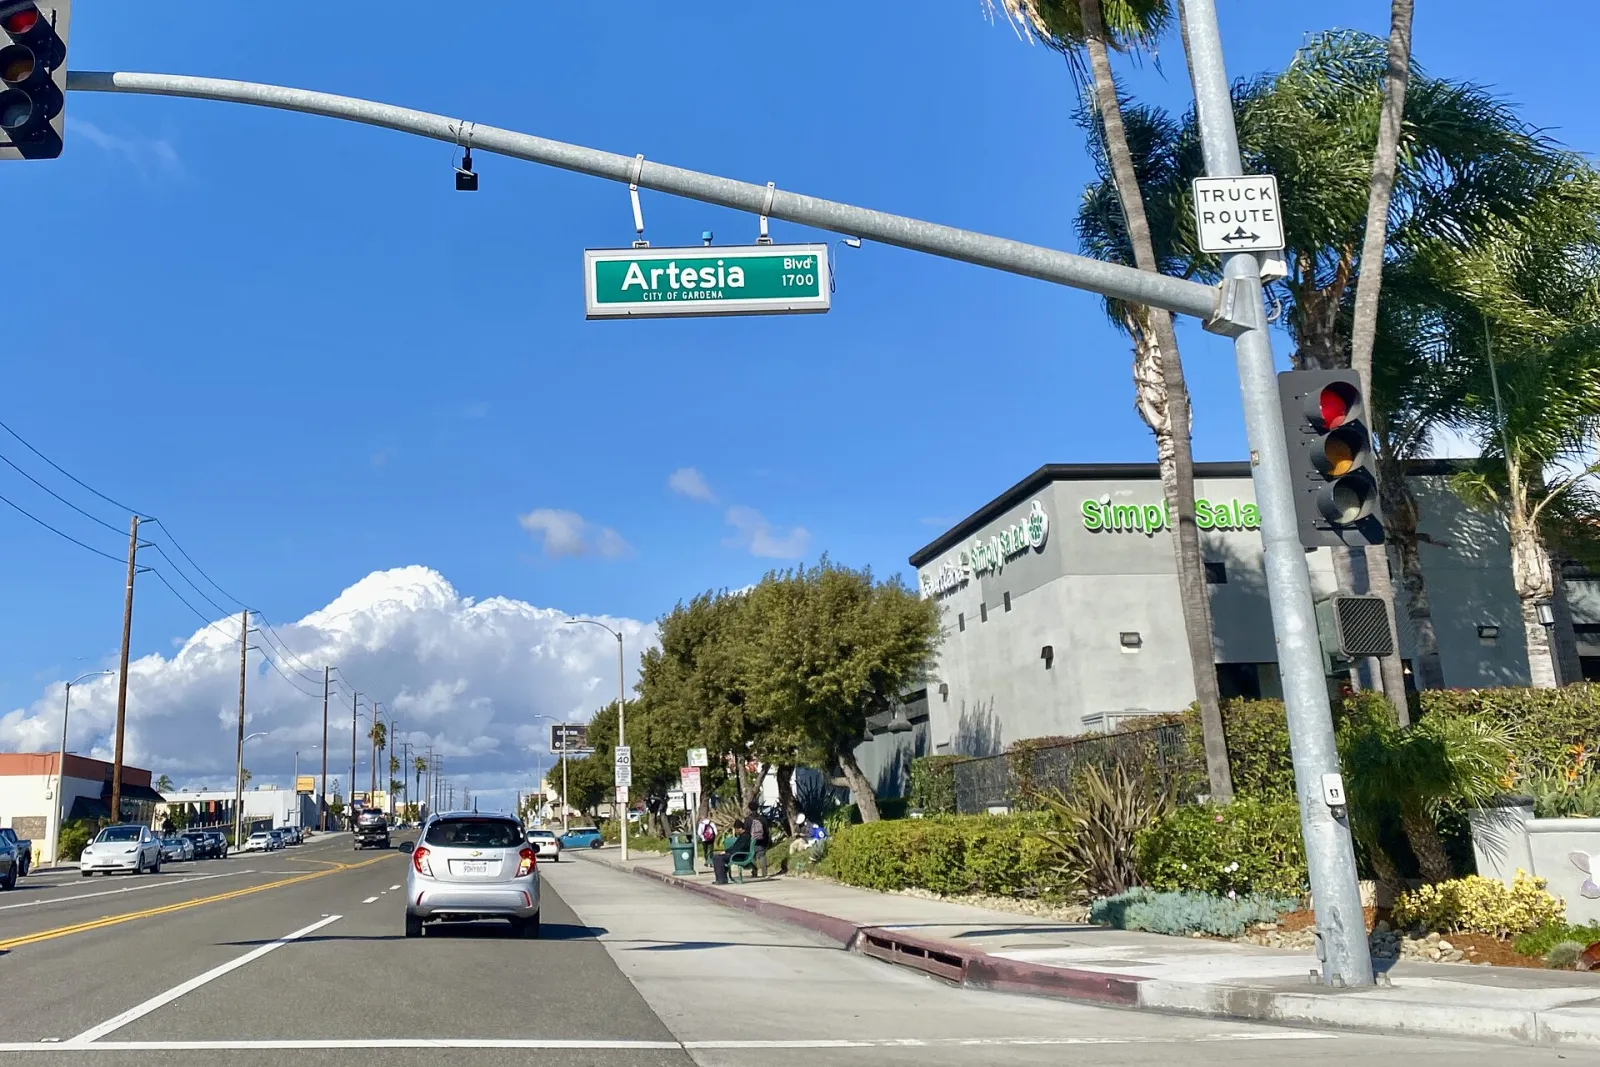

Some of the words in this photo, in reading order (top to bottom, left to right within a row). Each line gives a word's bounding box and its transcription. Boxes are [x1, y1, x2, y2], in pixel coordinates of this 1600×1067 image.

[1199, 187, 1272, 202] TRUCK
[1203, 209, 1274, 224] ROUTE
[783, 257, 811, 270] Blvd
[621, 259, 745, 291] Artesia
[781, 273, 814, 287] 1700
[643, 291, 662, 301] CITY
[666, 291, 678, 300] OF
[682, 290, 723, 300] GARDENA
[1081, 494, 1172, 534] Simpl
[1195, 498, 1261, 529] Sala
[616, 756, 629, 764] 40
